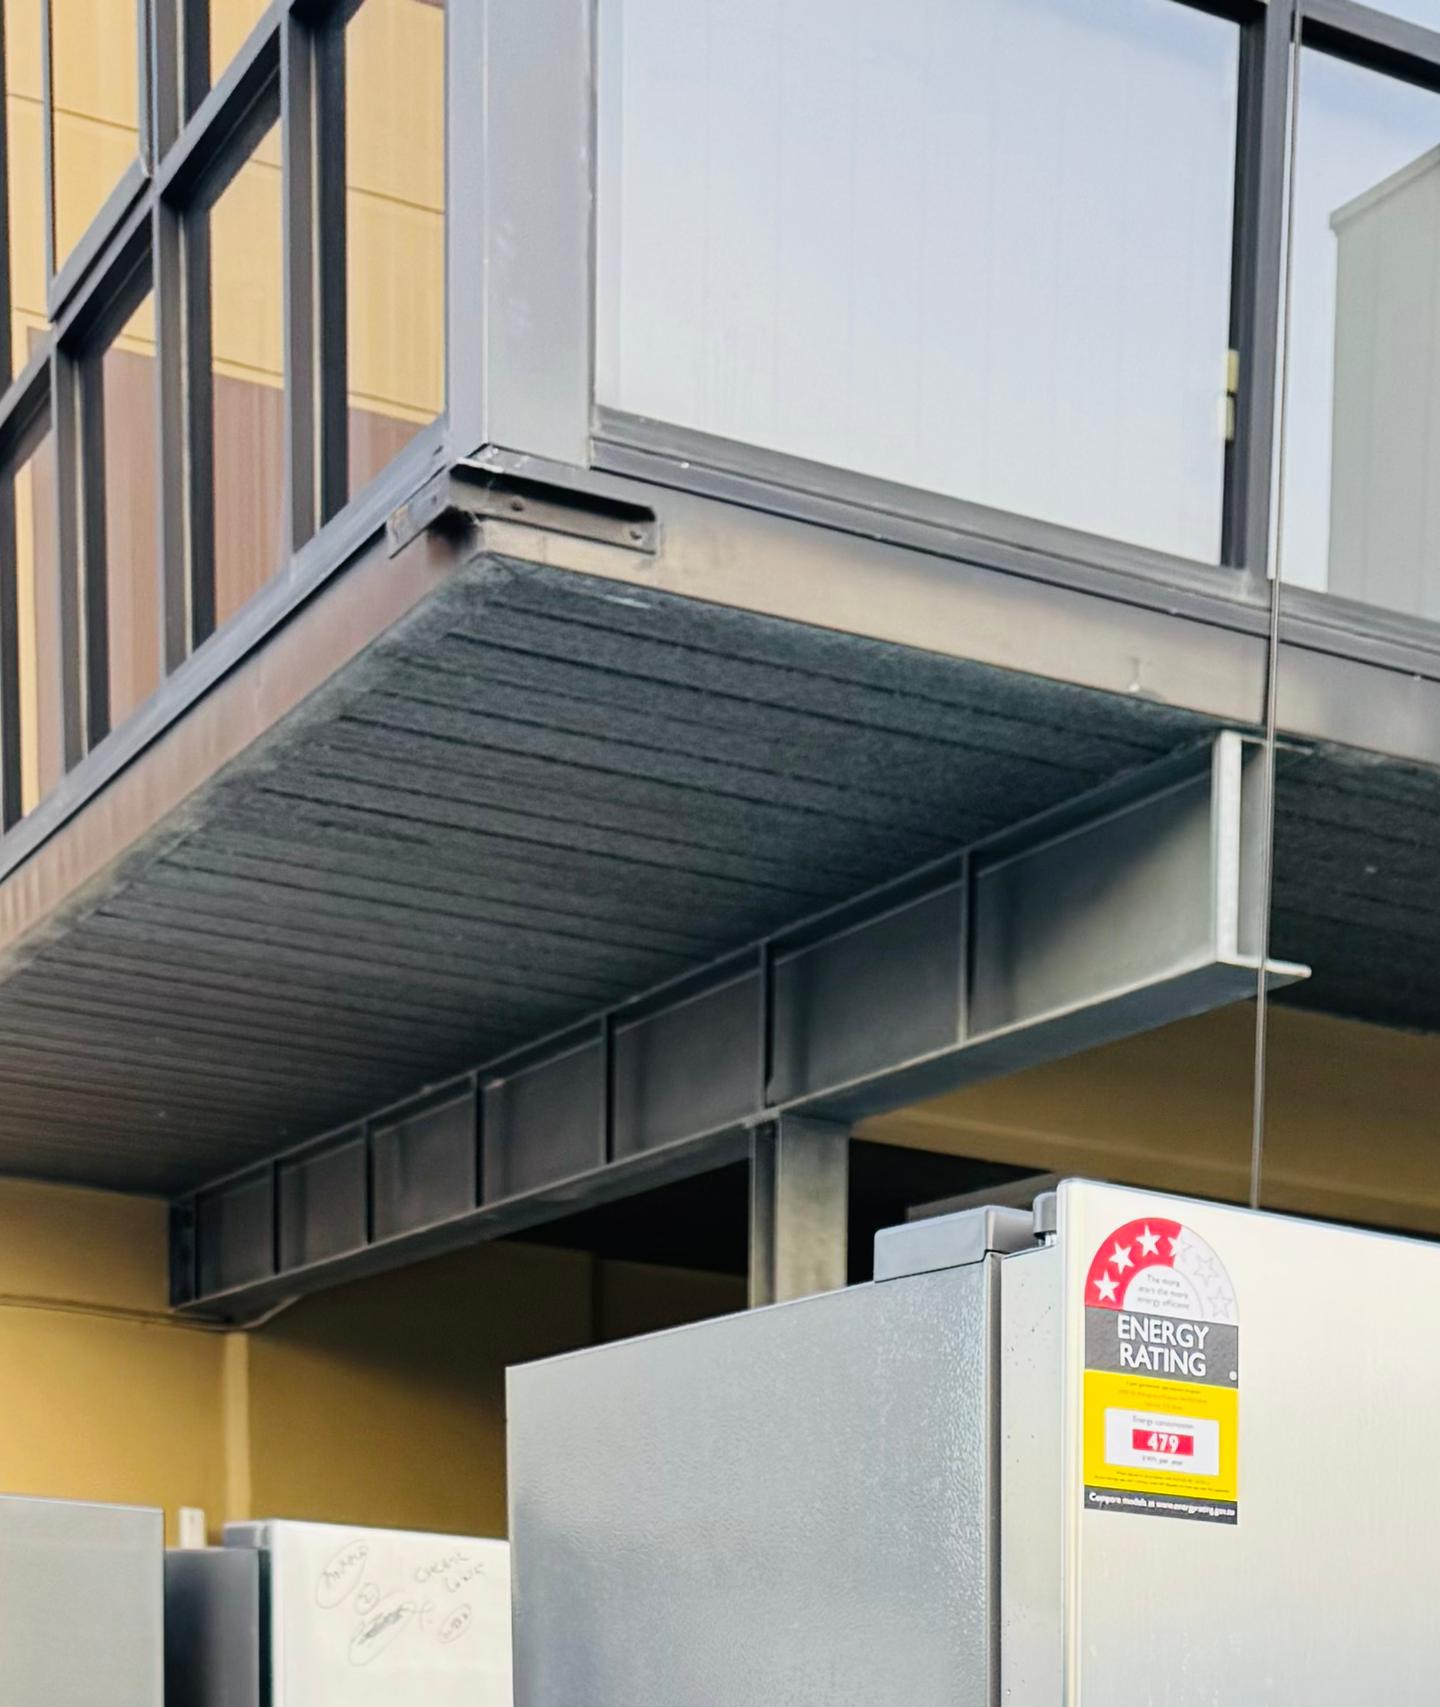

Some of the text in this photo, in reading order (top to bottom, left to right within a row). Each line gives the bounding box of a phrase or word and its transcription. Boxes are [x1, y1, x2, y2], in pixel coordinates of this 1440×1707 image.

[1117, 1313, 1209, 1350] ENERGY
[1119, 1342, 1207, 1377] RATING
[1147, 1431, 1180, 1454] 479
